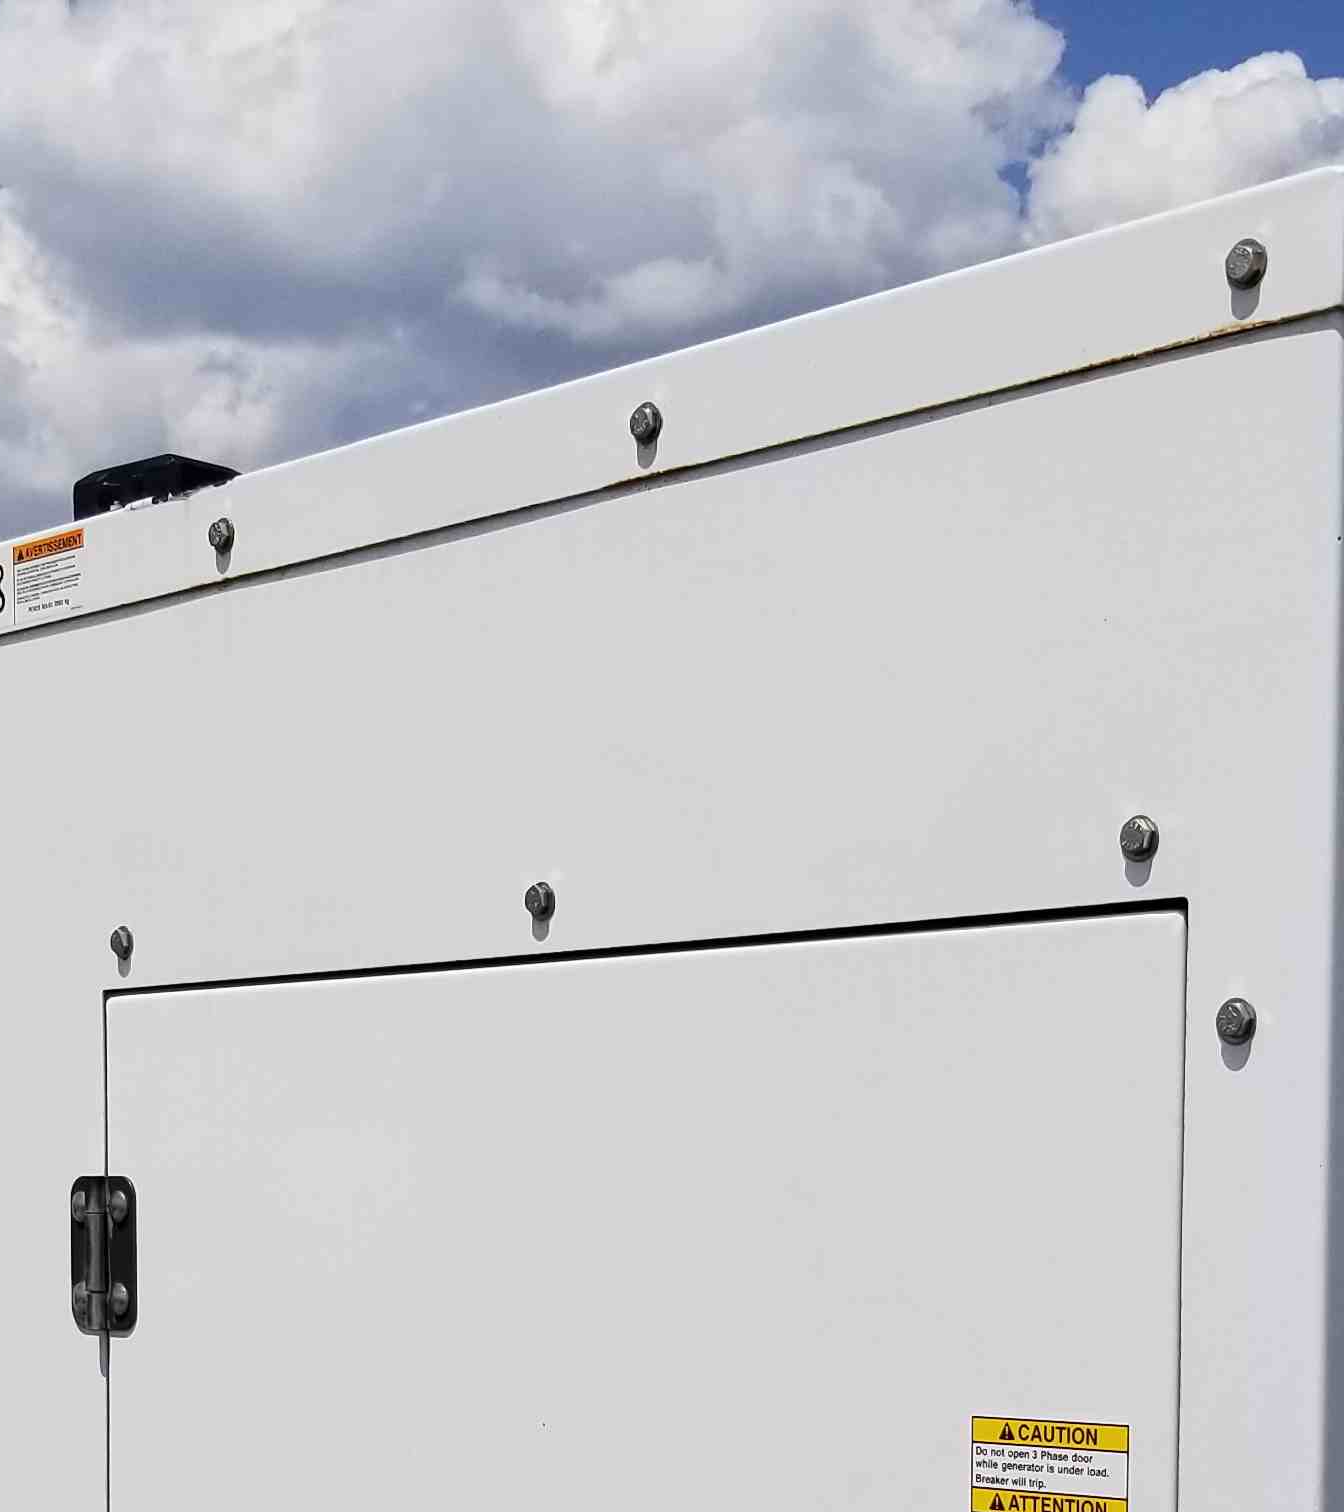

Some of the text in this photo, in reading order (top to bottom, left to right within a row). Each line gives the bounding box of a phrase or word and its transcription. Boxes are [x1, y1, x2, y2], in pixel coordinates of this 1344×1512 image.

[1018, 1424, 1097, 1445] CAUTION
[991, 1447, 1004, 1457] not
[1007, 1449, 1029, 1460] open
[1041, 1451, 1068, 1461] Phase
[1072, 1453, 1092, 1463] door
[975, 1459, 997, 1469] while
[1001, 1462, 1044, 1474] generator
[1057, 1465, 1083, 1475] under
[1087, 1467, 1109, 1477] load.
[975, 1474, 1046, 1490] Breaker will trip.
